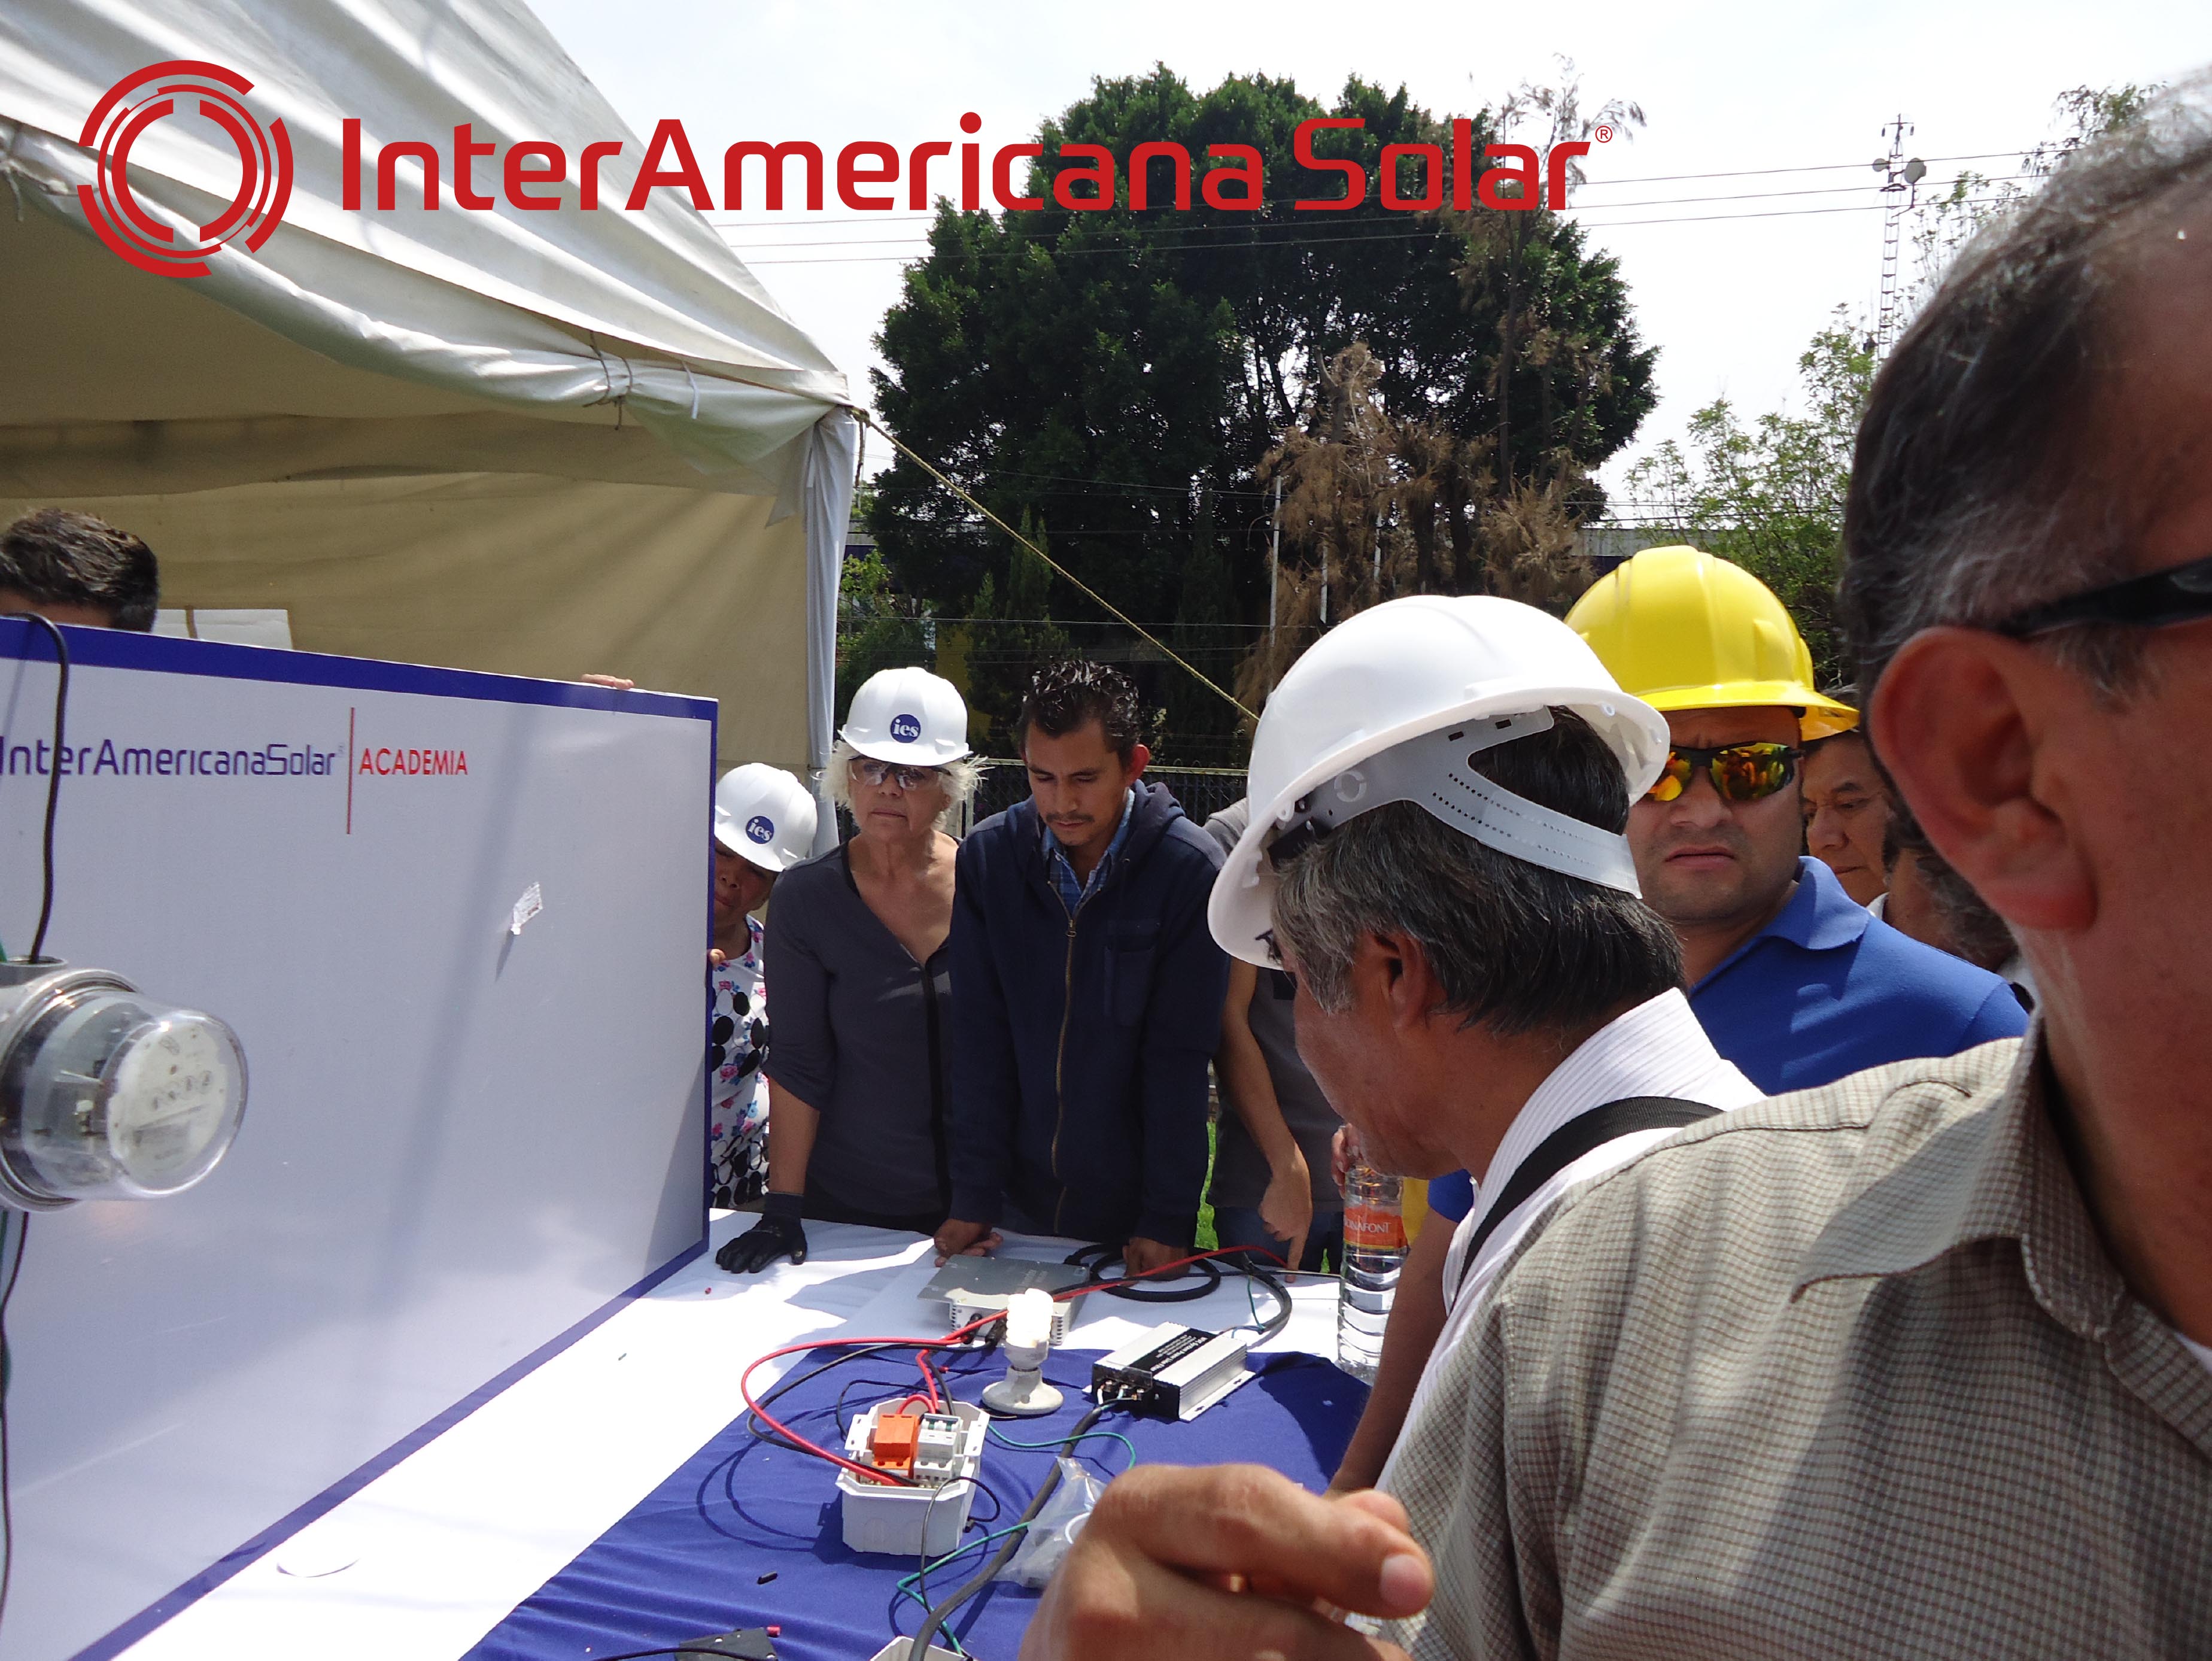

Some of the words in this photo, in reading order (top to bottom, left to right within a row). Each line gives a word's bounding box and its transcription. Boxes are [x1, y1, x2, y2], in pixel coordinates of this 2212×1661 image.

[892, 718, 919, 737] ies
[359, 748, 469, 776] ACADEMIA
[748, 818, 773, 841] ies
